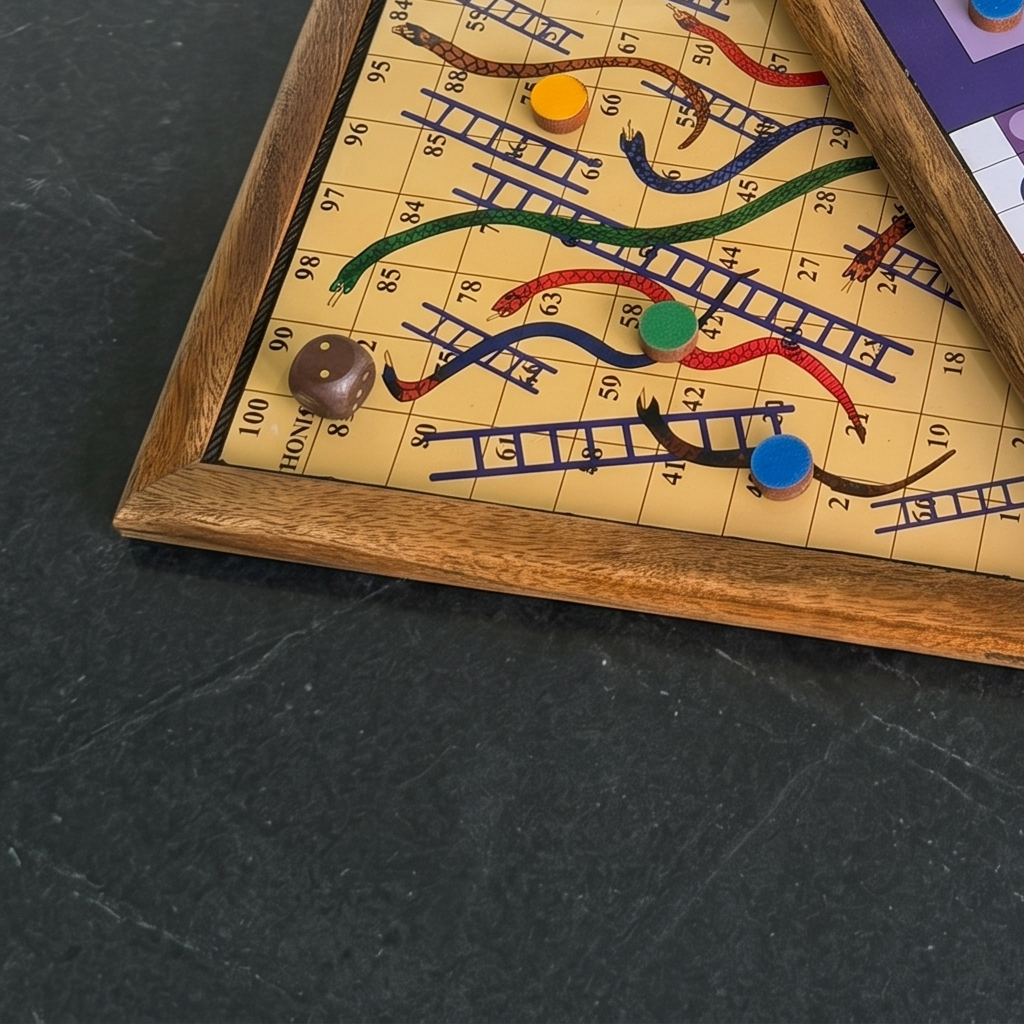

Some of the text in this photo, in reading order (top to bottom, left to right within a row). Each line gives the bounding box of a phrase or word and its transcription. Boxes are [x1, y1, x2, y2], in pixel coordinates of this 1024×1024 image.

[618, 32, 641, 54] 67
[367, 60, 391, 84] 95
[344, 122, 368, 146] 96
[423, 133, 447, 157] 85
[320, 187, 345, 211] 97
[737, 179, 758, 203] 45
[814, 190, 836, 215] 28
[400, 200, 425, 224] 84
[295, 255, 320, 281] 98
[719, 246, 742, 269] 44
[797, 257, 820, 282] 27
[377, 268, 401, 293] 85
[457, 280, 482, 303] 78
[539, 292, 562, 316] 63
[944, 352, 966, 375] 18
[682, 387, 705, 411] 42
[239, 398, 269, 437] 100
[828, 497, 849, 511] 2
[1000, 512, 1020, 523] 1
